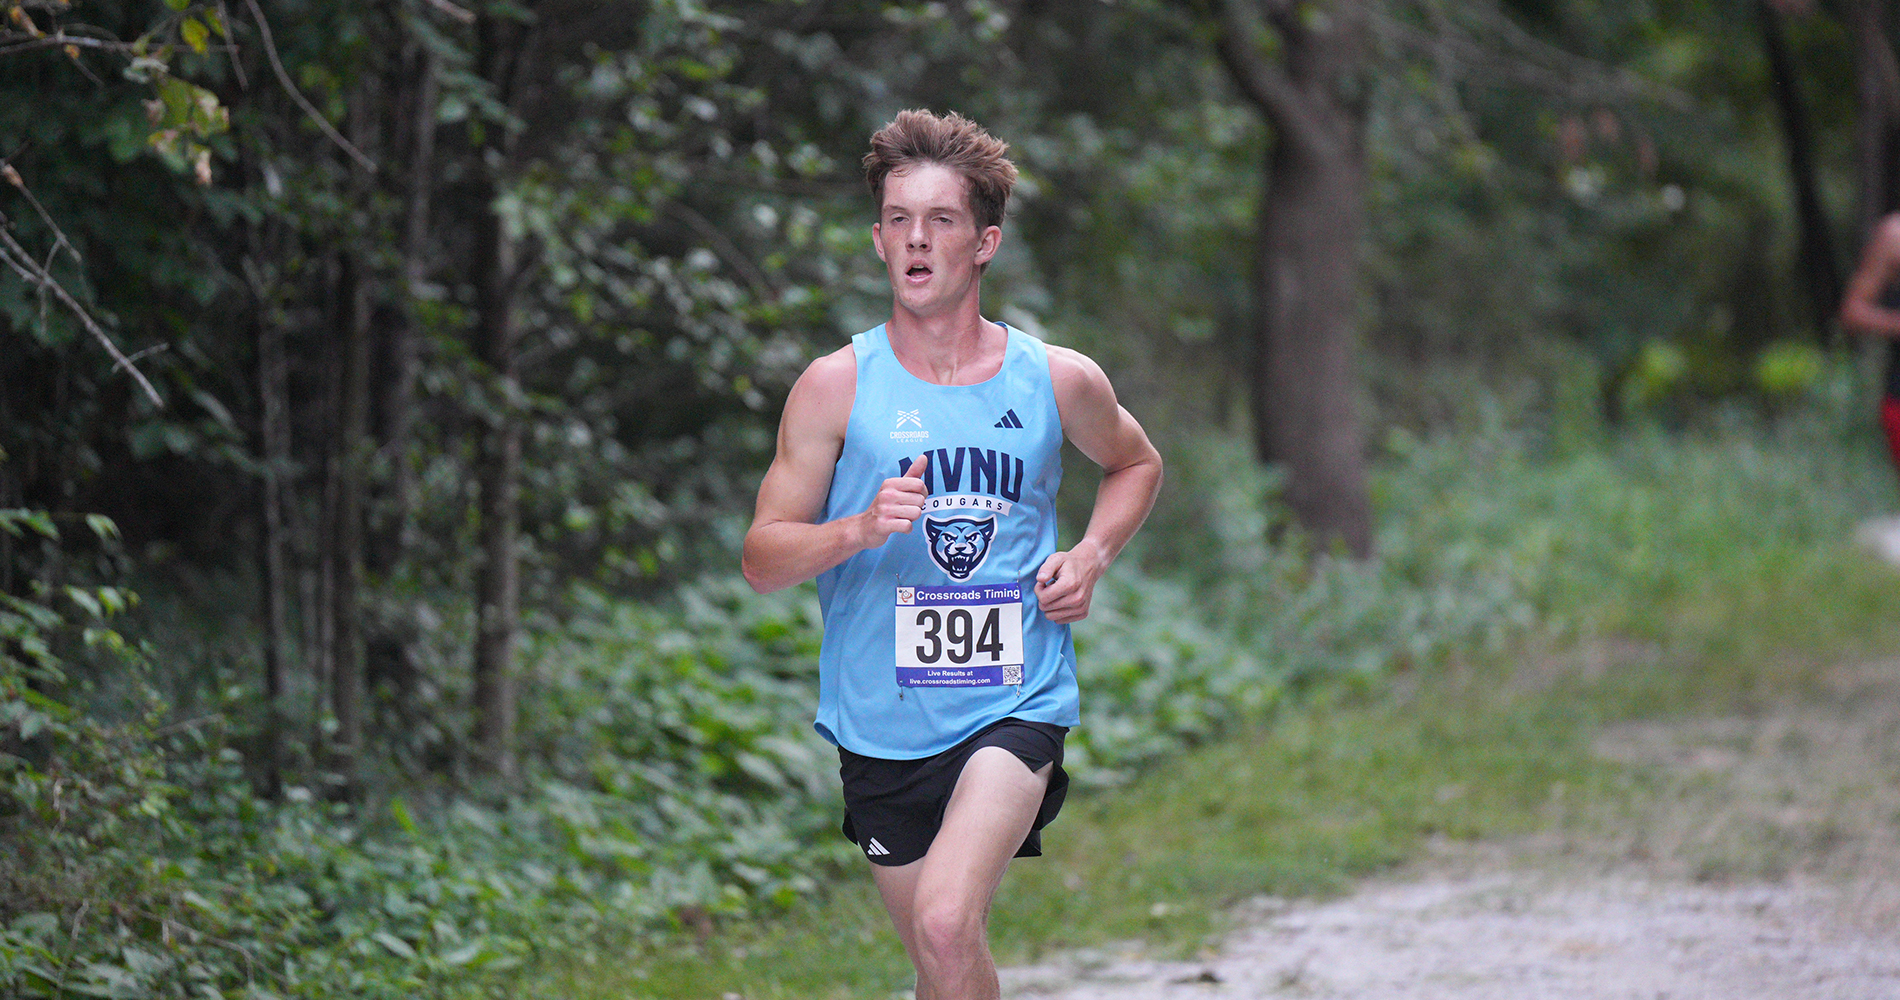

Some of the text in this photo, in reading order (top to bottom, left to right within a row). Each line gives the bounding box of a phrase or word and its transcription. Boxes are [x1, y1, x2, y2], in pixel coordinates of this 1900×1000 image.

[890, 431, 929, 439] CROSSROADS
[916, 588, 1020, 600] Crossroads Timing
[916, 607, 1004, 664] 394
